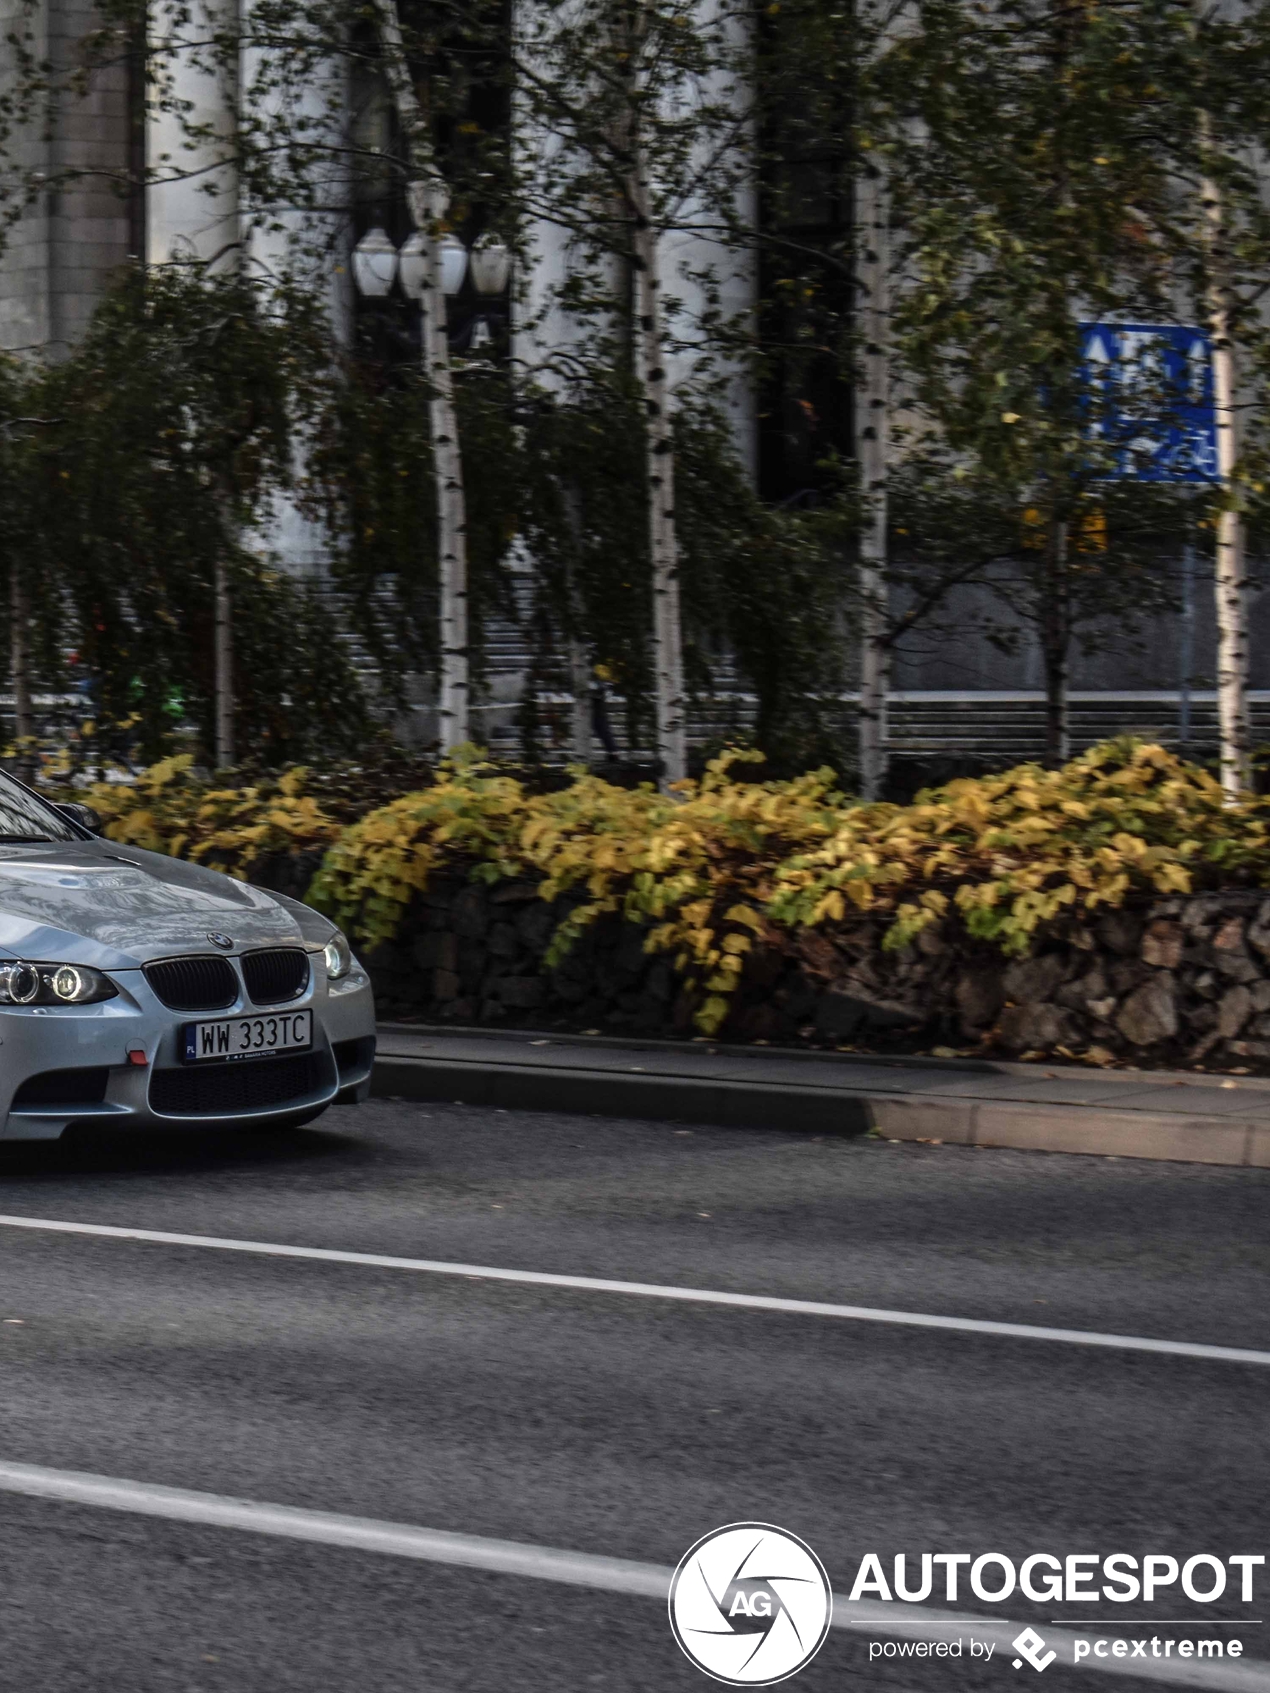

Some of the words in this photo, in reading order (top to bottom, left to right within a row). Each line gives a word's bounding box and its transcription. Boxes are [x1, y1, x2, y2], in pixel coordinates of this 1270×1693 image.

[201, 1023, 230, 1054] WW
[239, 1014, 305, 1050] 333TC
[186, 1045, 195, 1054] PL
